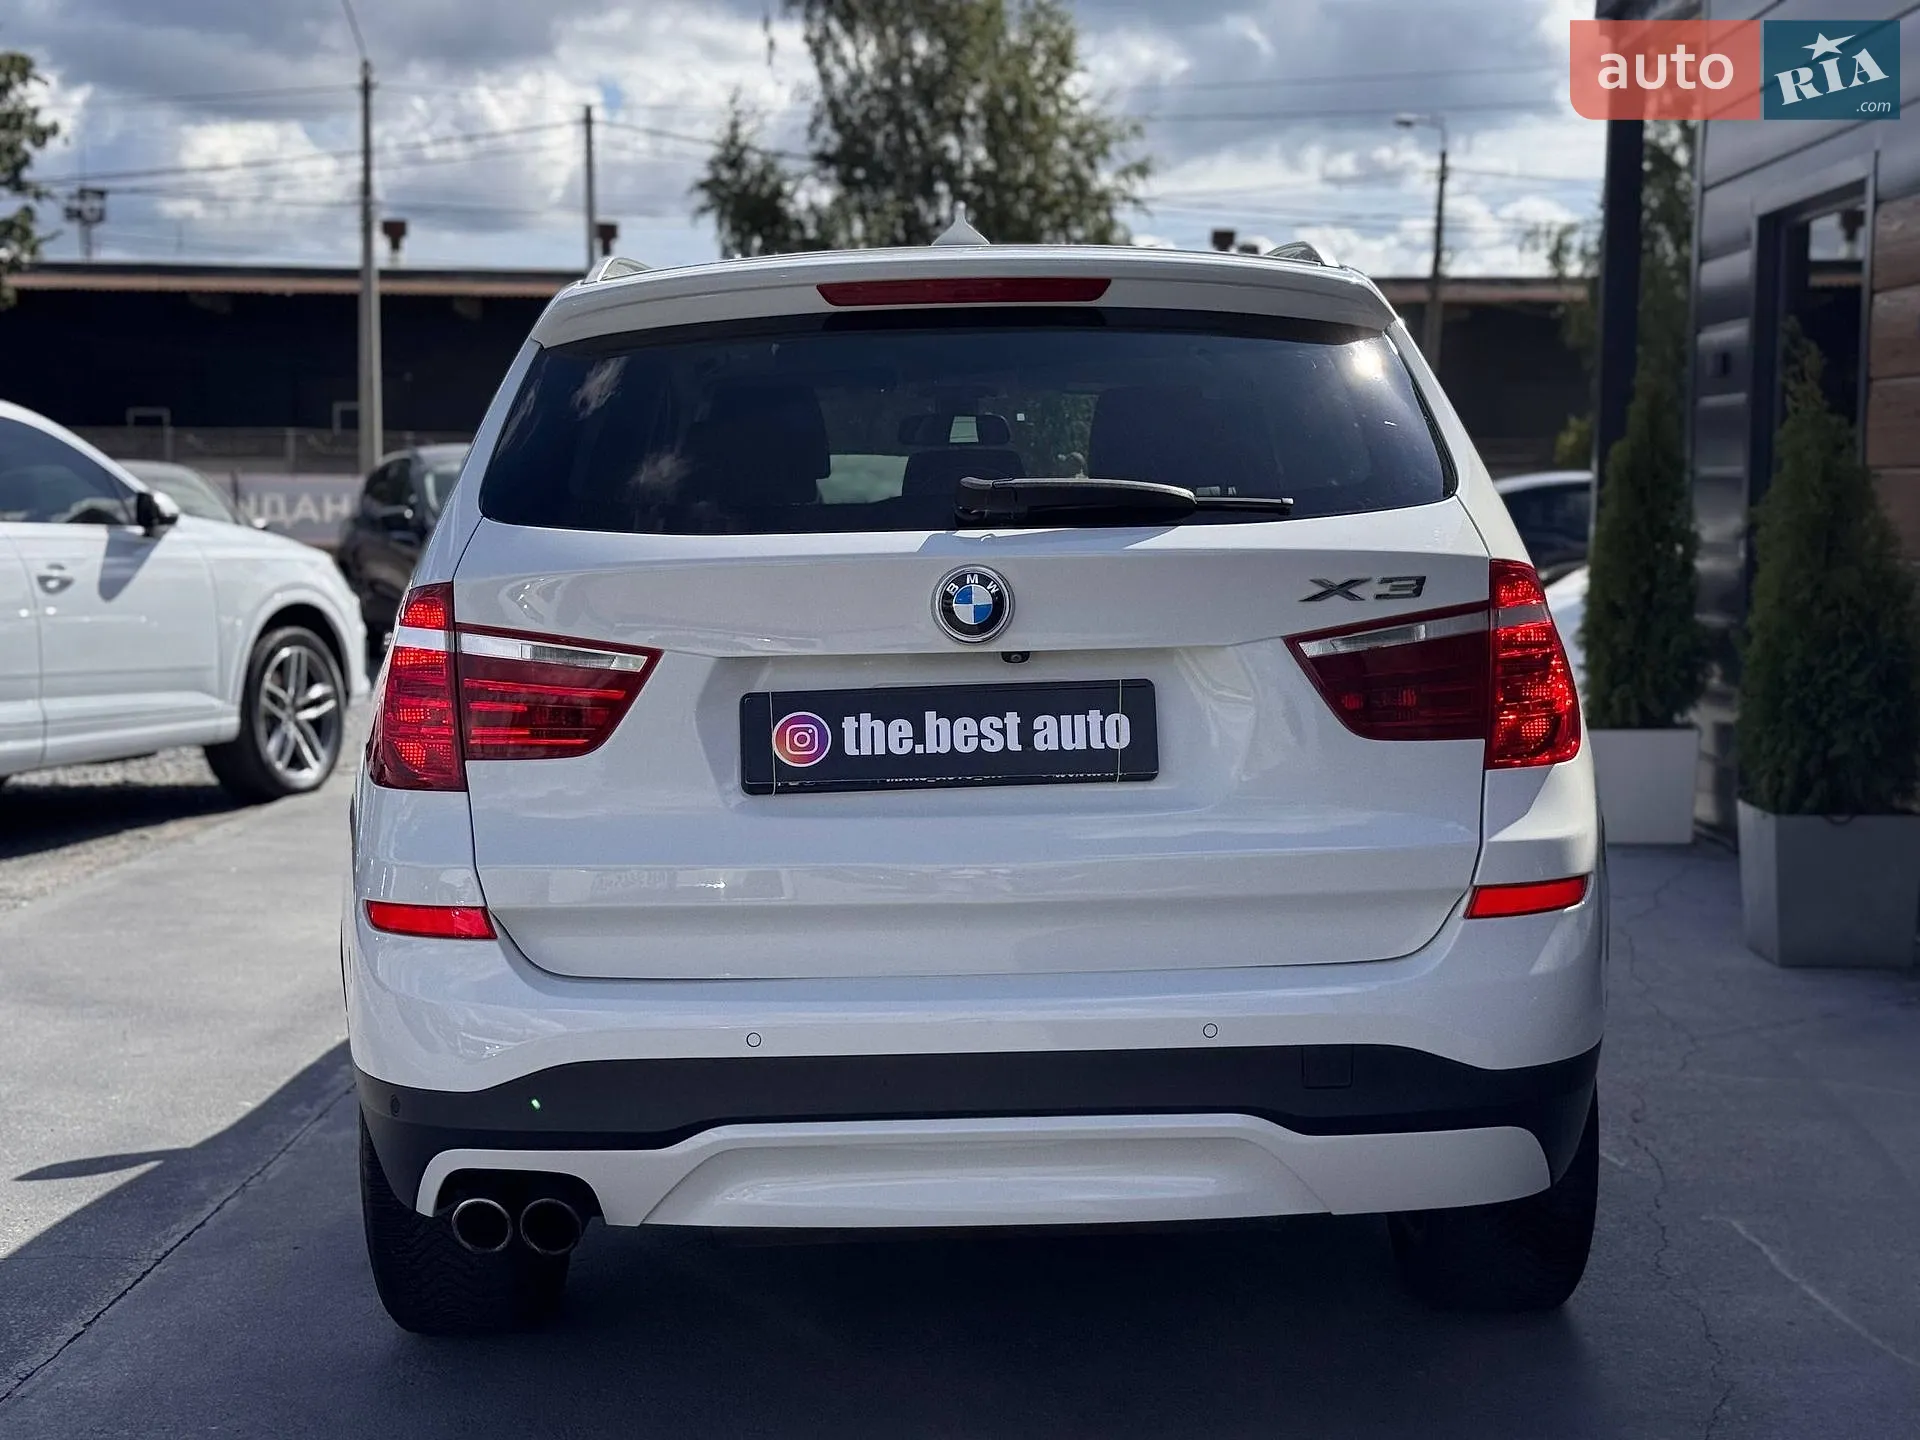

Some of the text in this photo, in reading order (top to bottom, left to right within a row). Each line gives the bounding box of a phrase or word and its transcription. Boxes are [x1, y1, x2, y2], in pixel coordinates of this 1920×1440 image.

[946, 574, 999, 596] BMW
[1299, 576, 1426, 602] X3
[842, 710, 1131, 755] the.best auto
